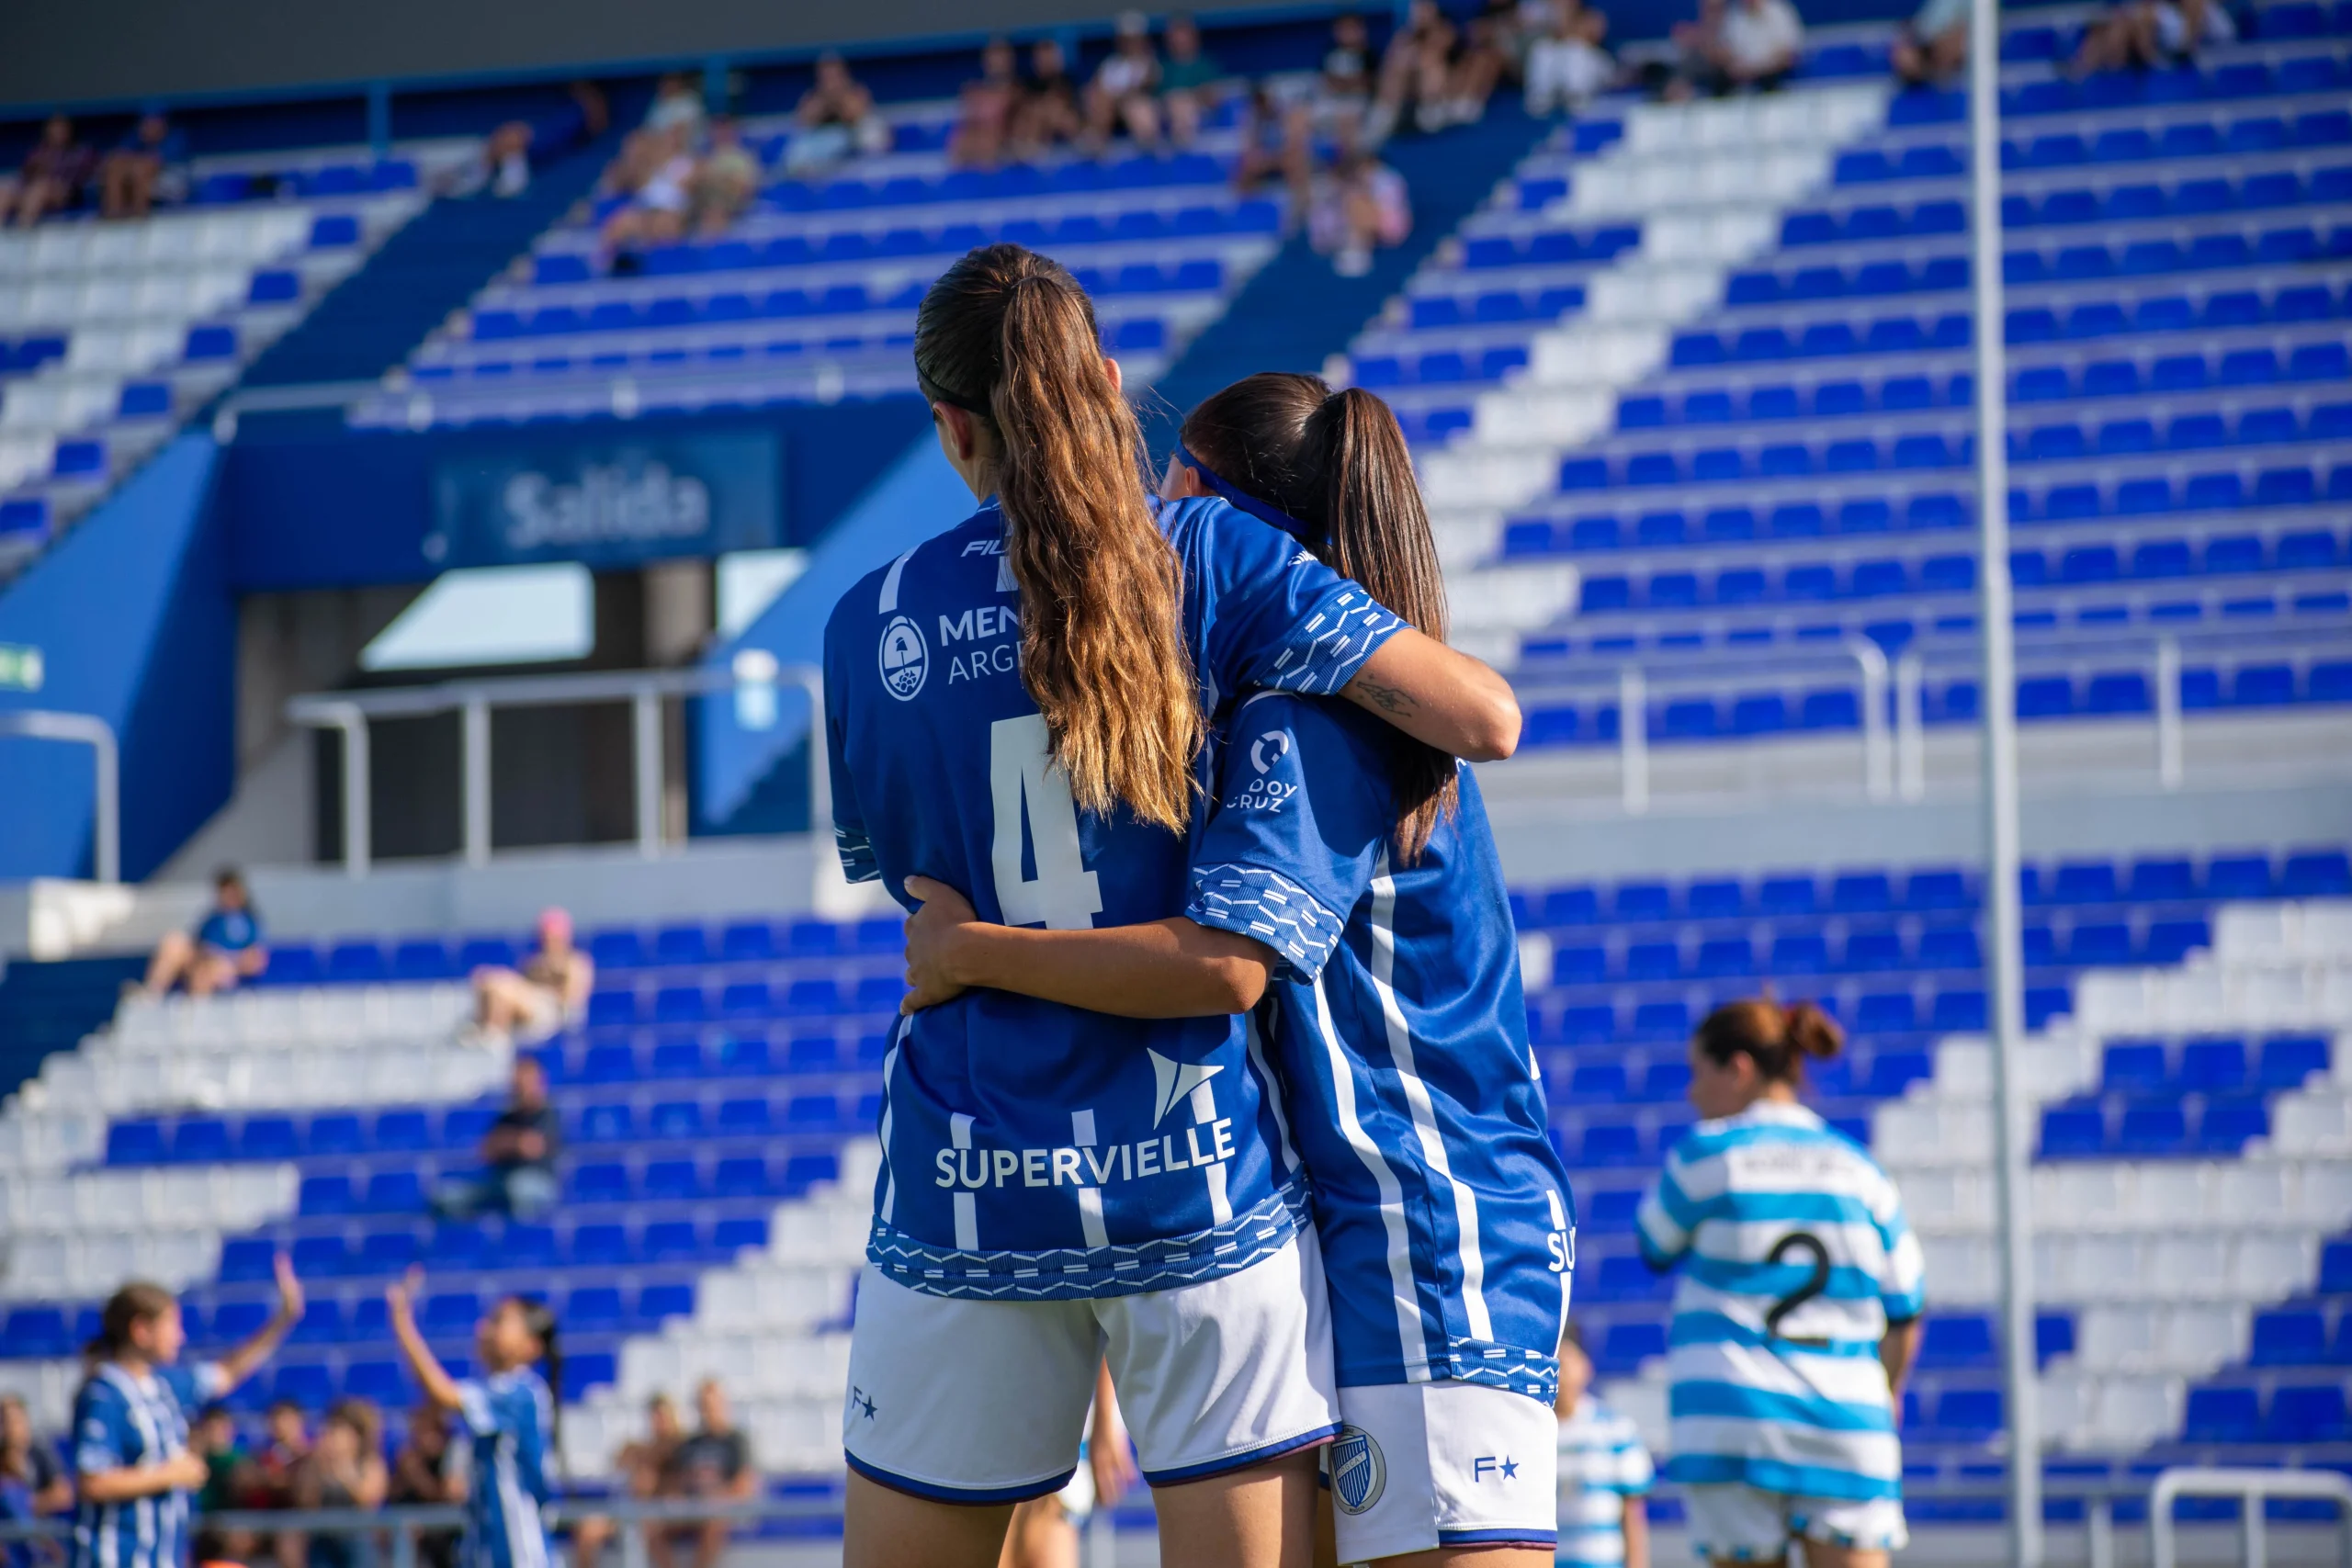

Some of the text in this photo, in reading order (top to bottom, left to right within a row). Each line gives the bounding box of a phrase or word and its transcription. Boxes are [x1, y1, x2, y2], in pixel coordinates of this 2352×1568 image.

[506, 463, 708, 548] Salida
[960, 539, 1007, 558] FIL
[939, 605, 1022, 647] MEN
[948, 640, 1023, 685] ARG
[1249, 778, 1298, 797] DOY
[990, 713, 1102, 930] 4
[935, 1118, 1236, 1188] SUPERVIELLE
[1547, 1231, 1575, 1272] SU
[1766, 1233, 1830, 1347] 2
[1474, 1456, 1496, 1483] F
